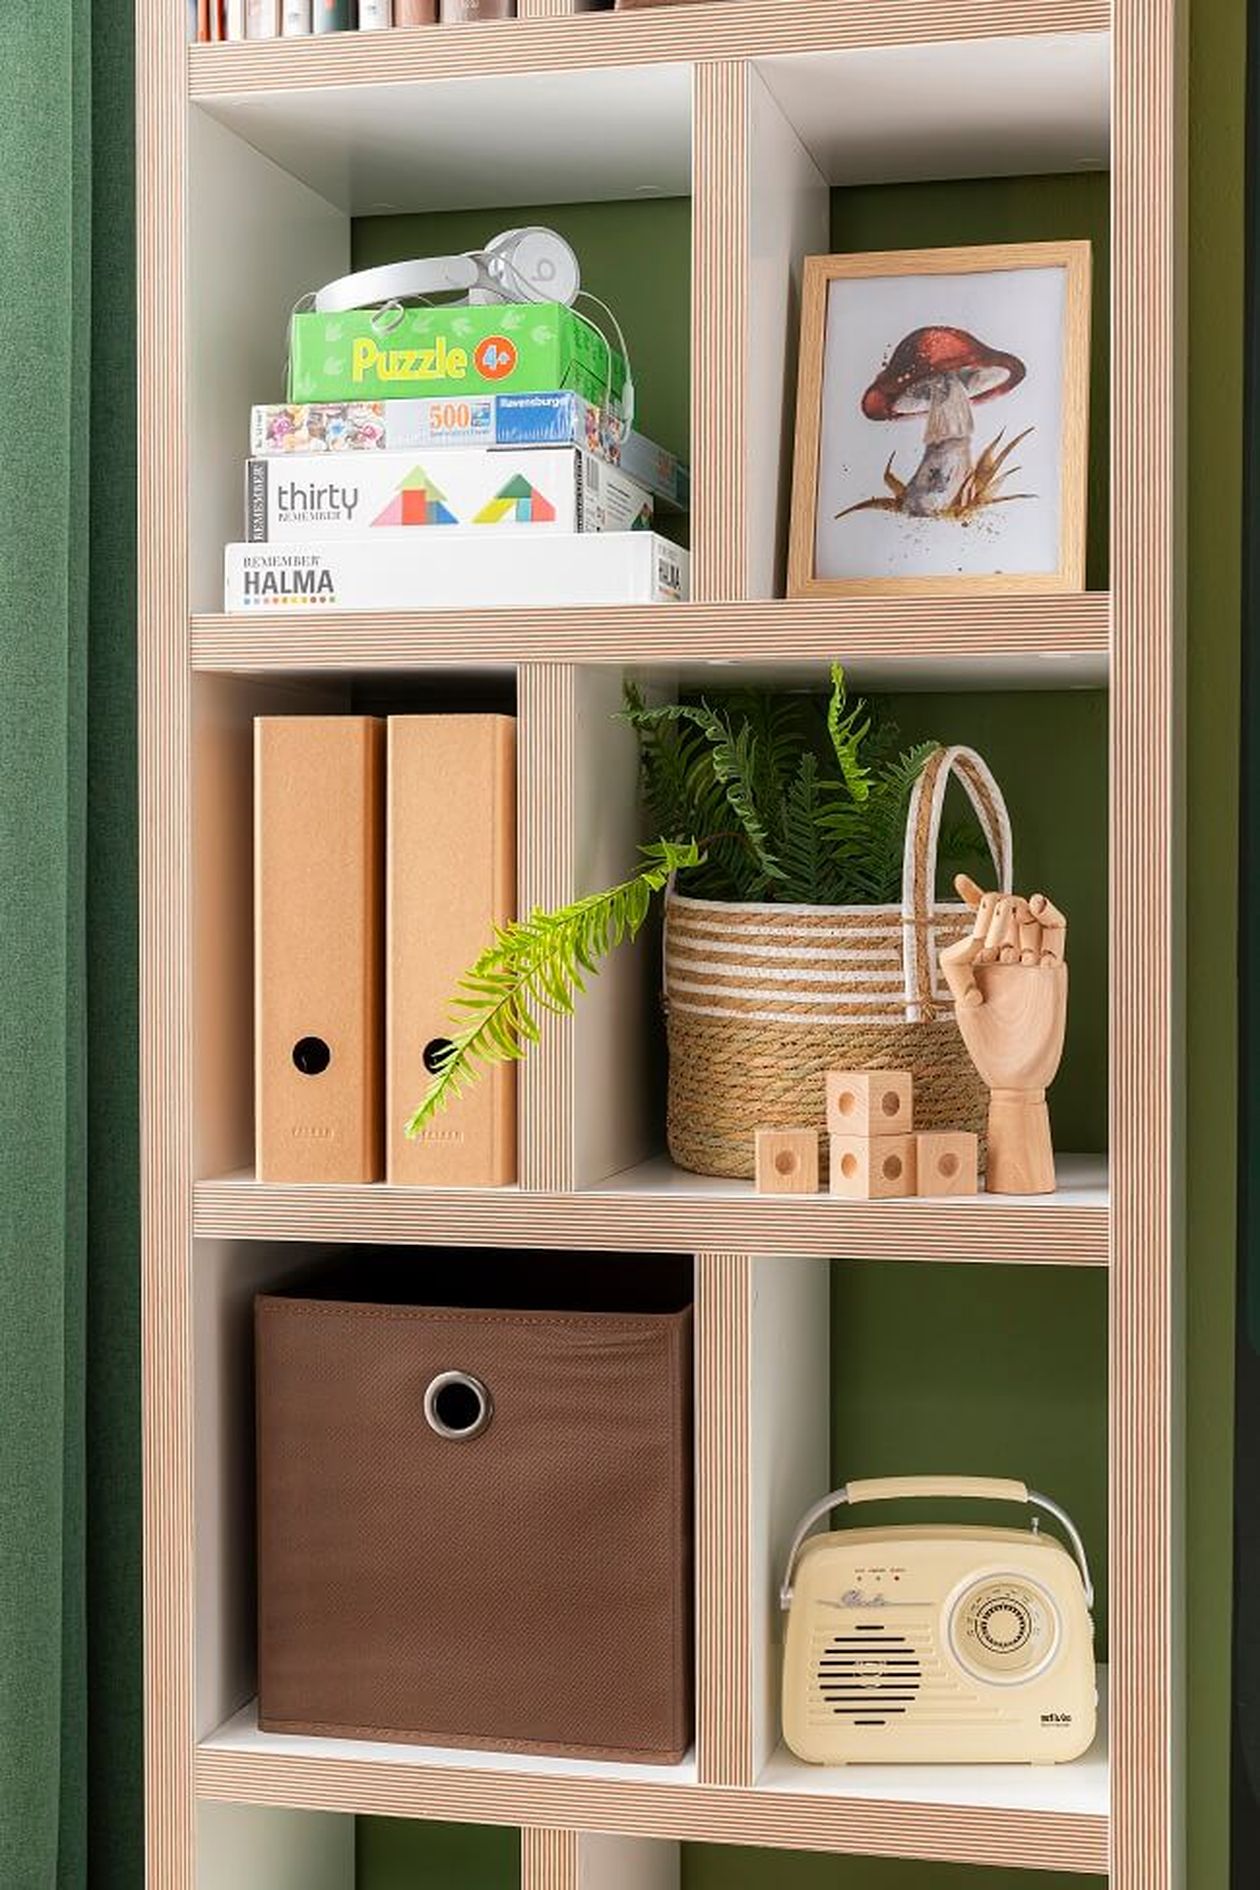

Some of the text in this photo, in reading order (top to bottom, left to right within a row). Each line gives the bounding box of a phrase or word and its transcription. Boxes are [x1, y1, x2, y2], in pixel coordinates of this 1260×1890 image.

[352, 336, 467, 381] Puzzle
[482, 344, 511, 371] 4+
[429, 402, 470, 430] 500
[252, 463, 265, 543] REMEMBER
[278, 482, 358, 520] thirty
[278, 510, 342, 523] REMEMBER
[243, 554, 320, 568] REMEMBER
[244, 569, 334, 594] HALMA
